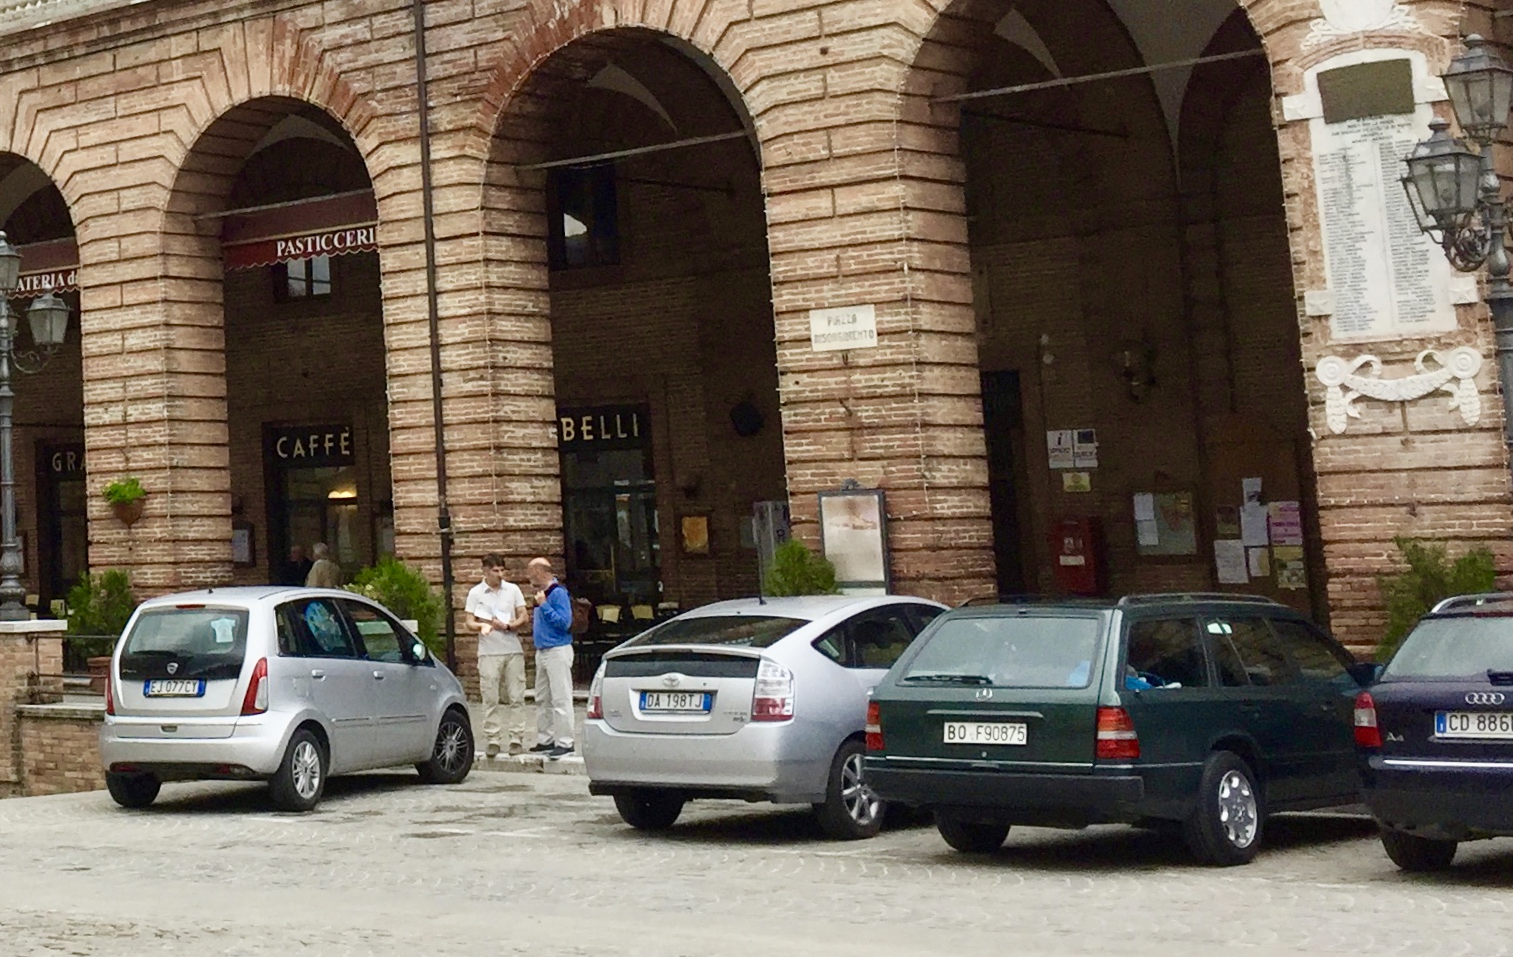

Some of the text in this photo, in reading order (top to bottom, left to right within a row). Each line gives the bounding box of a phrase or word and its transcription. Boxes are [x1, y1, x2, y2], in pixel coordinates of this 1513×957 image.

[275, 227, 375, 257] PASTICCERI
[560, 412, 639, 442] BELLI
[276, 426, 350, 459] CAFFÈ
[150, 680, 198, 693] EJ 077CY
[647, 693, 703, 708] DA 198TJ
[1449, 714, 1470, 732] CD
[975, 724, 1026, 742] F90875
